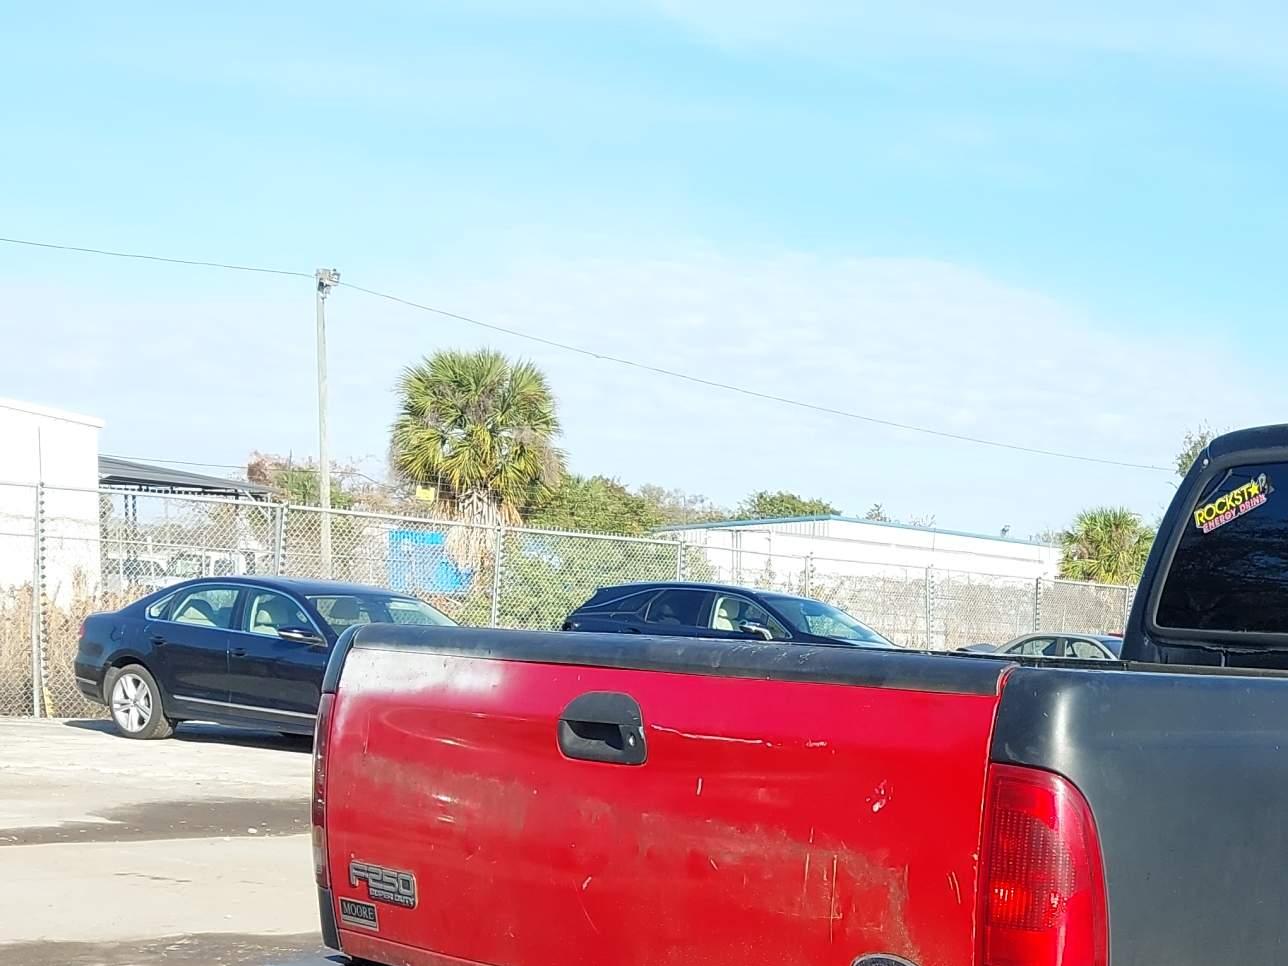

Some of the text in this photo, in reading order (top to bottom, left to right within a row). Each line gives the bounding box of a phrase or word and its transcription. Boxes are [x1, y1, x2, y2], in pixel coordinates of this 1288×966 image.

[1203, 493, 1267, 533] ENERGY DRINK
[394, 895, 415, 906] DUTY
[342, 902, 375, 920] MOORE
